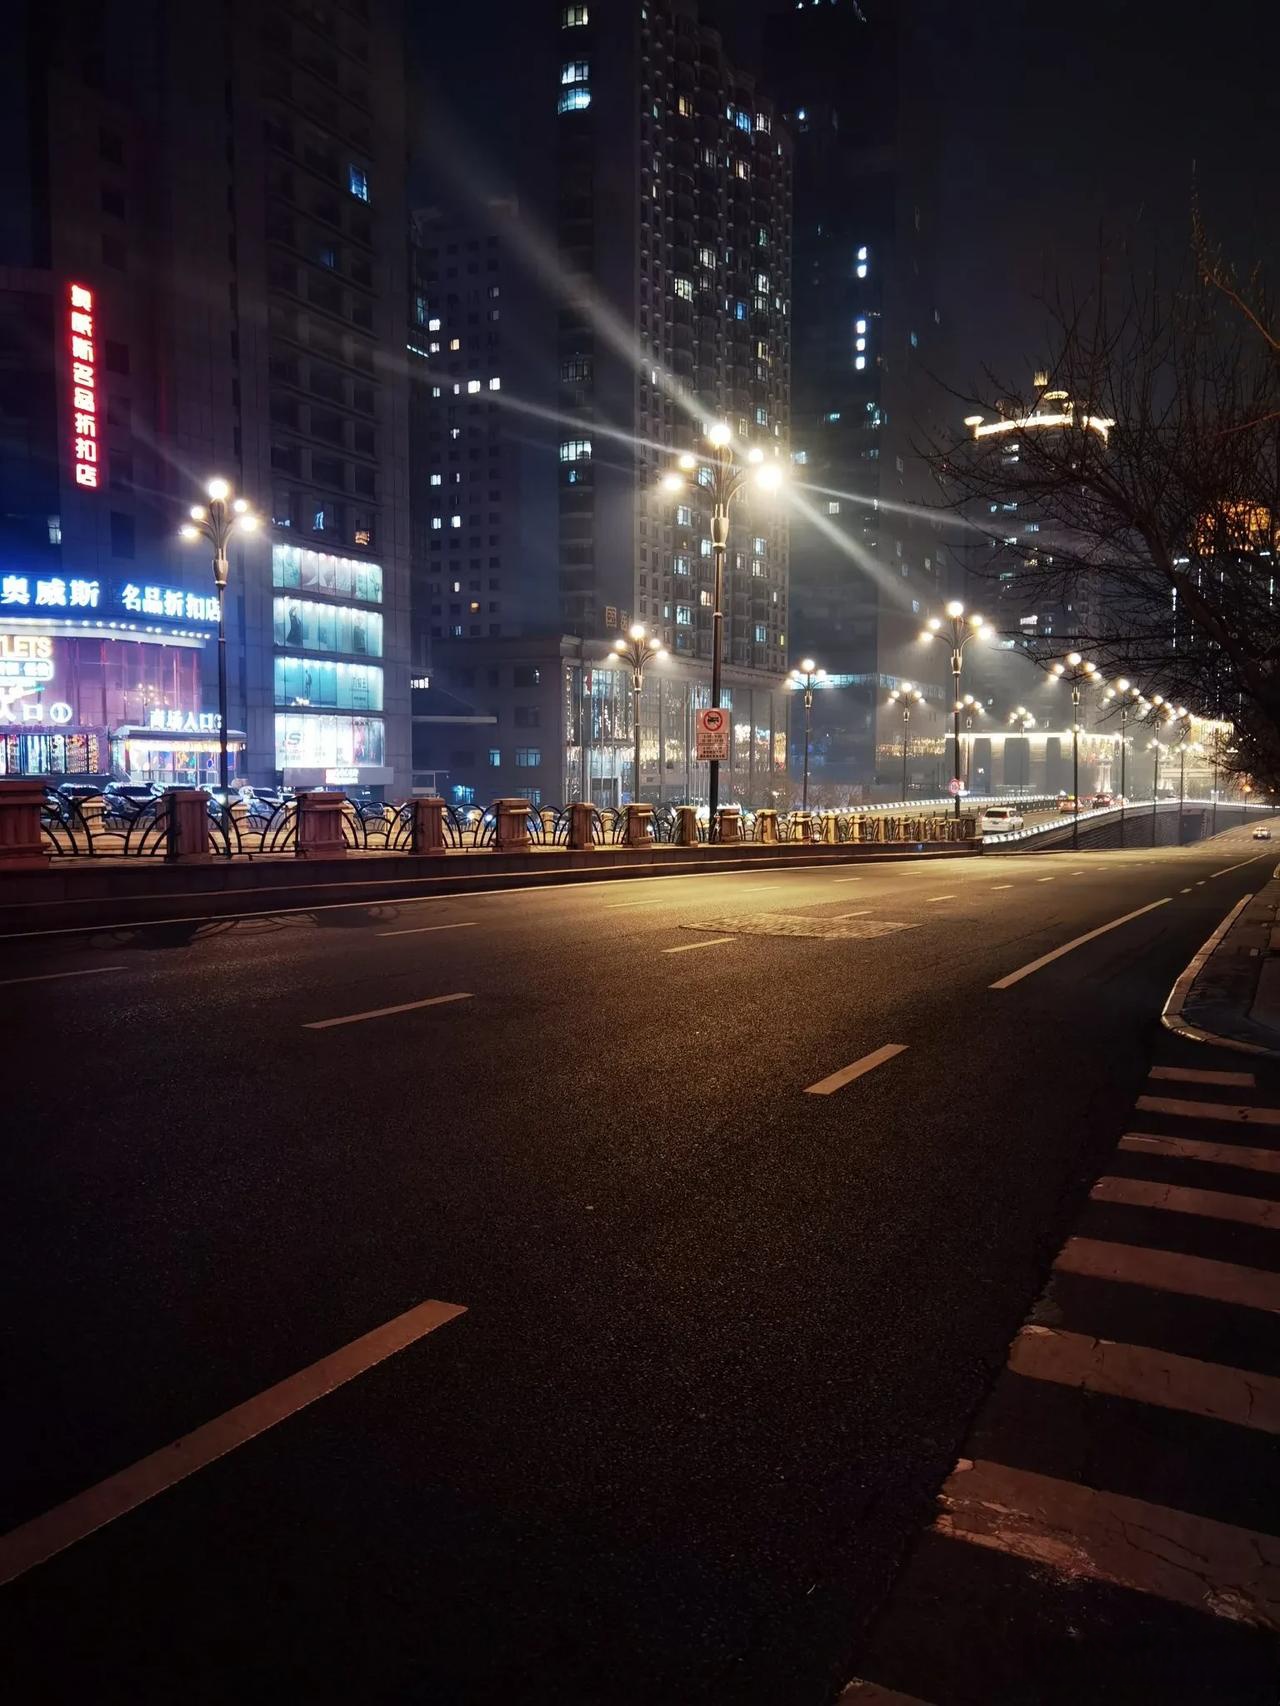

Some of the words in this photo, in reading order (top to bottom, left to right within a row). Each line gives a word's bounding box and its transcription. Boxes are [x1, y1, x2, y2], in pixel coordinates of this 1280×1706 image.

[121, 584, 221, 622] 名品折扣店
[0, 635, 52, 658] LETS
